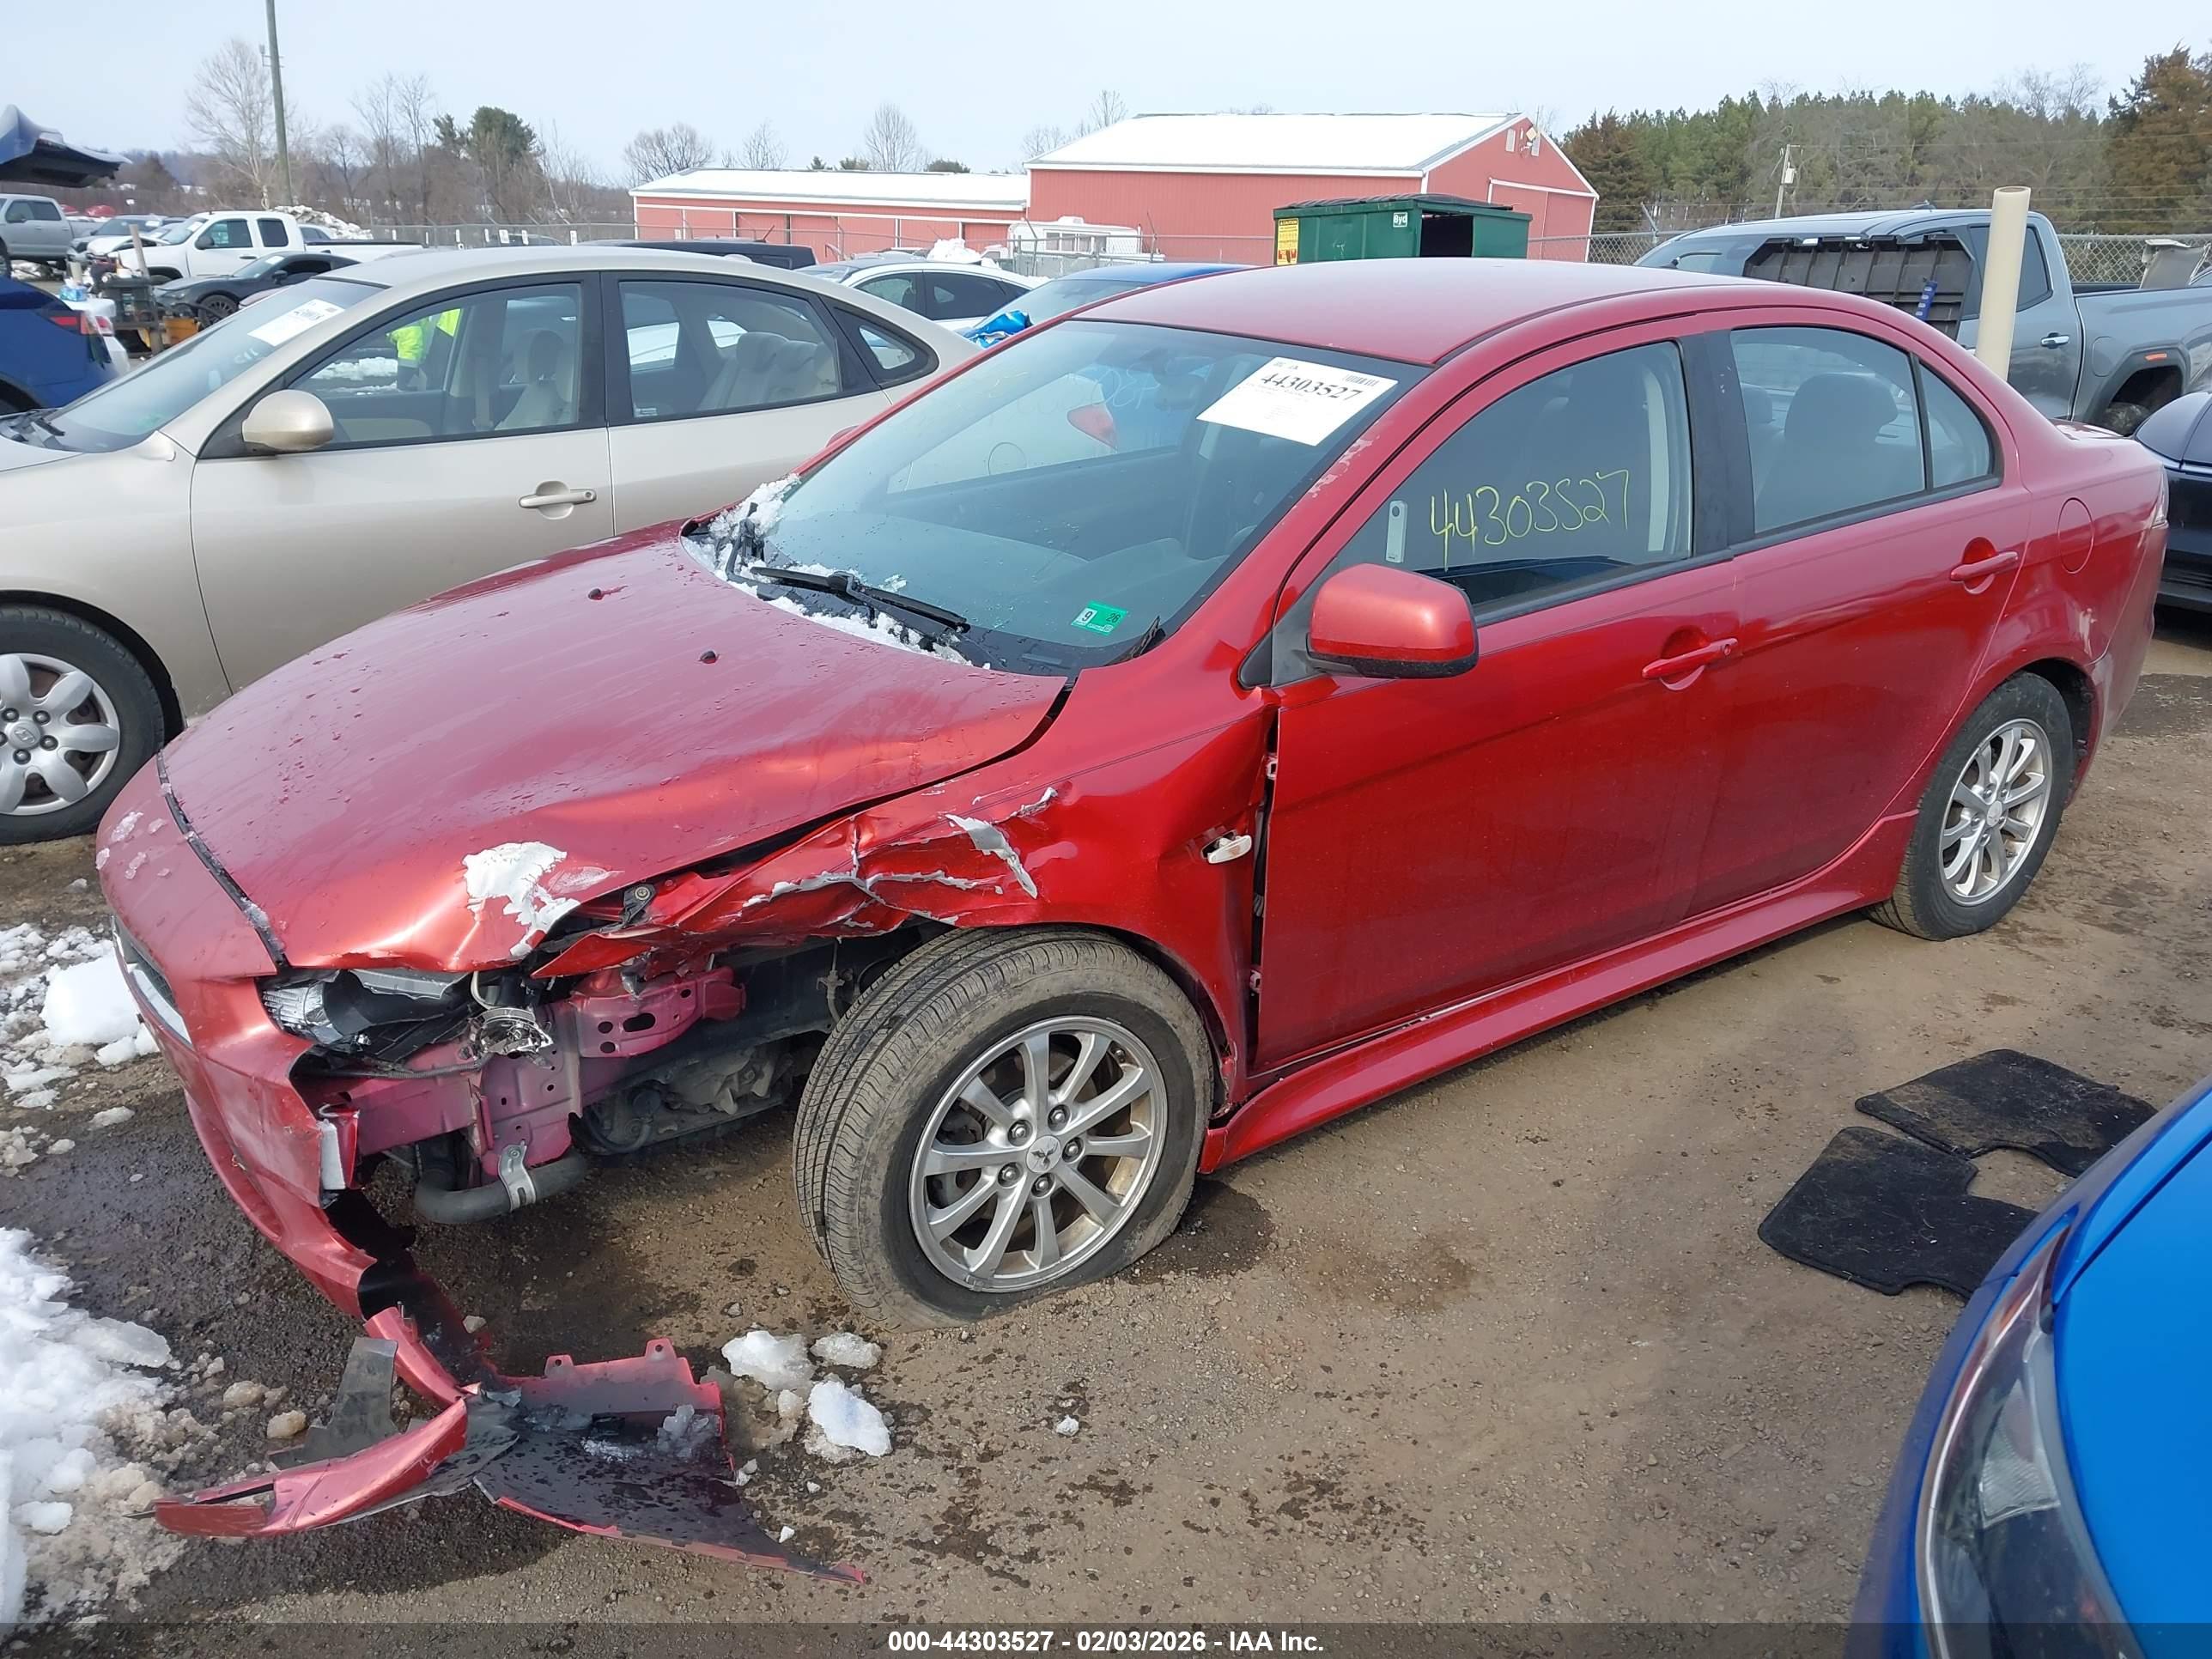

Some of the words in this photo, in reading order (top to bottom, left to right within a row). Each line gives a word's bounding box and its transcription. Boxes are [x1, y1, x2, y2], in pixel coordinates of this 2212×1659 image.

[1261, 373, 1364, 401] 44303527
[1430, 469, 1629, 572] 44303527
[1082, 611, 1093, 622] 9
[1106, 612, 1121, 623] 26
